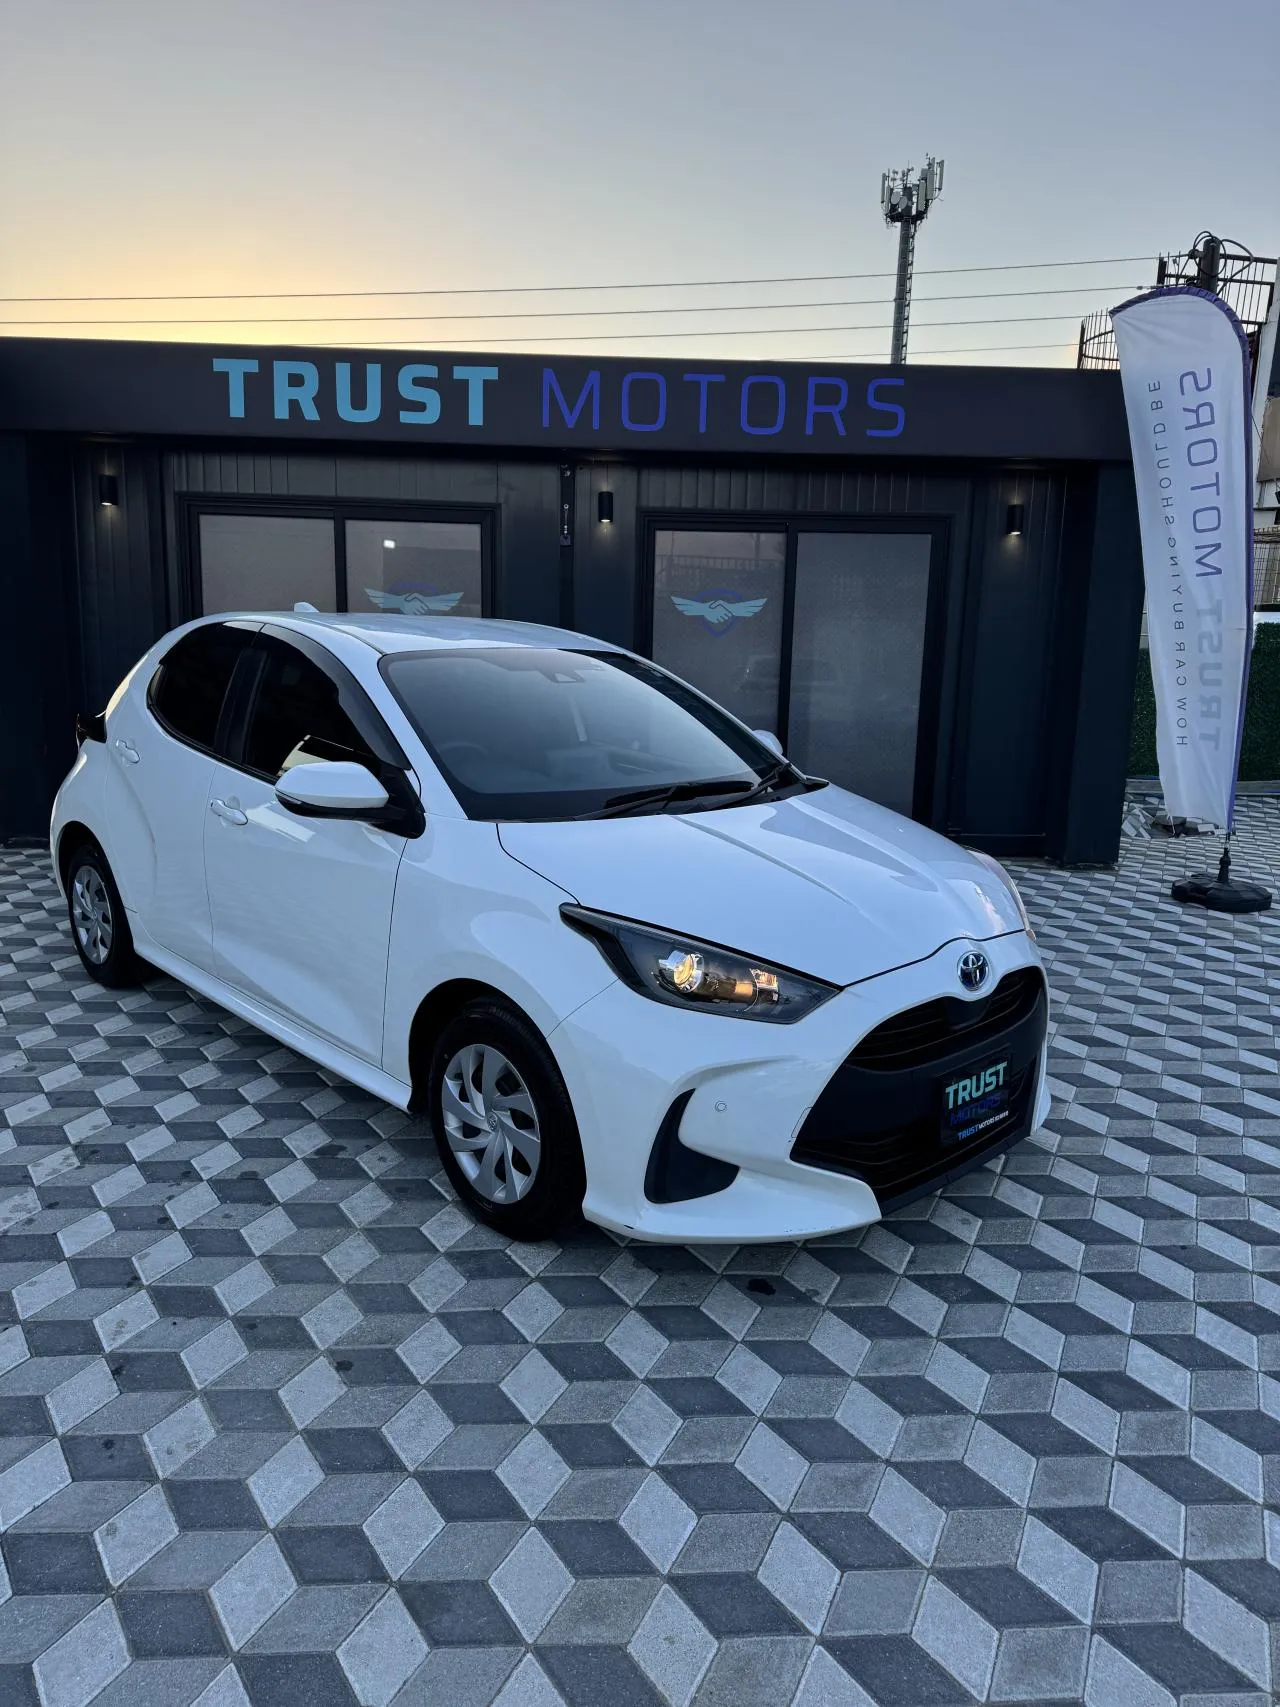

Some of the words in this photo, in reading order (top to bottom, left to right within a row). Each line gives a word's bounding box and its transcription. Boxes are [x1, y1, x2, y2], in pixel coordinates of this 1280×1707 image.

[212, 358, 499, 426] TRUST
[541, 367, 906, 438] MOTORS
[945, 1061, 1008, 1110] TRUST
[951, 1095, 1001, 1126] MOTORS
